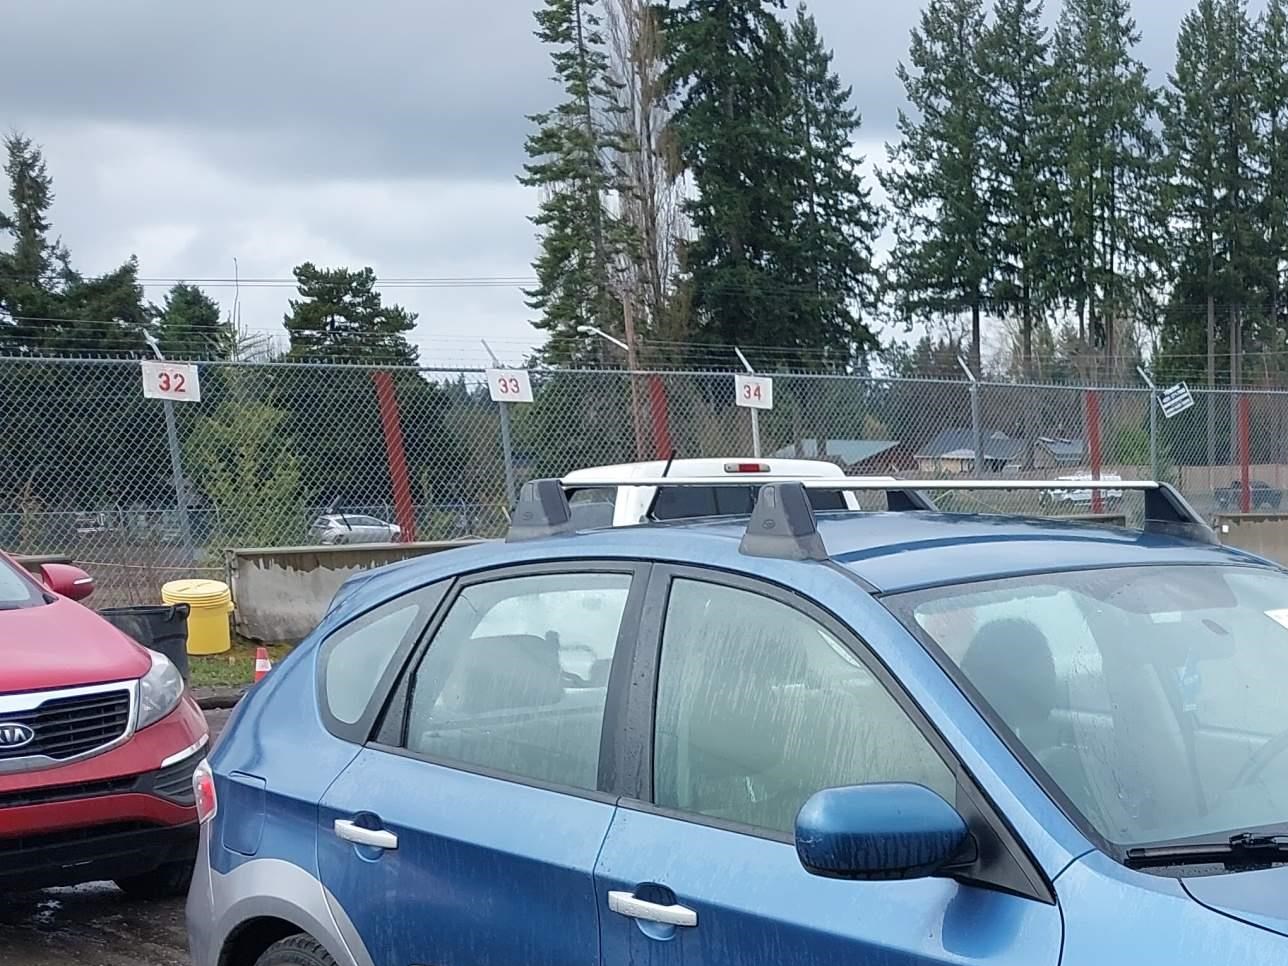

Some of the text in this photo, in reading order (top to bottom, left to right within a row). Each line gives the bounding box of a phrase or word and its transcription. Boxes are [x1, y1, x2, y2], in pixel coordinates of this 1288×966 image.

[158, 372, 186, 392] 32
[498, 377, 519, 394] 33
[743, 384, 761, 401] 34
